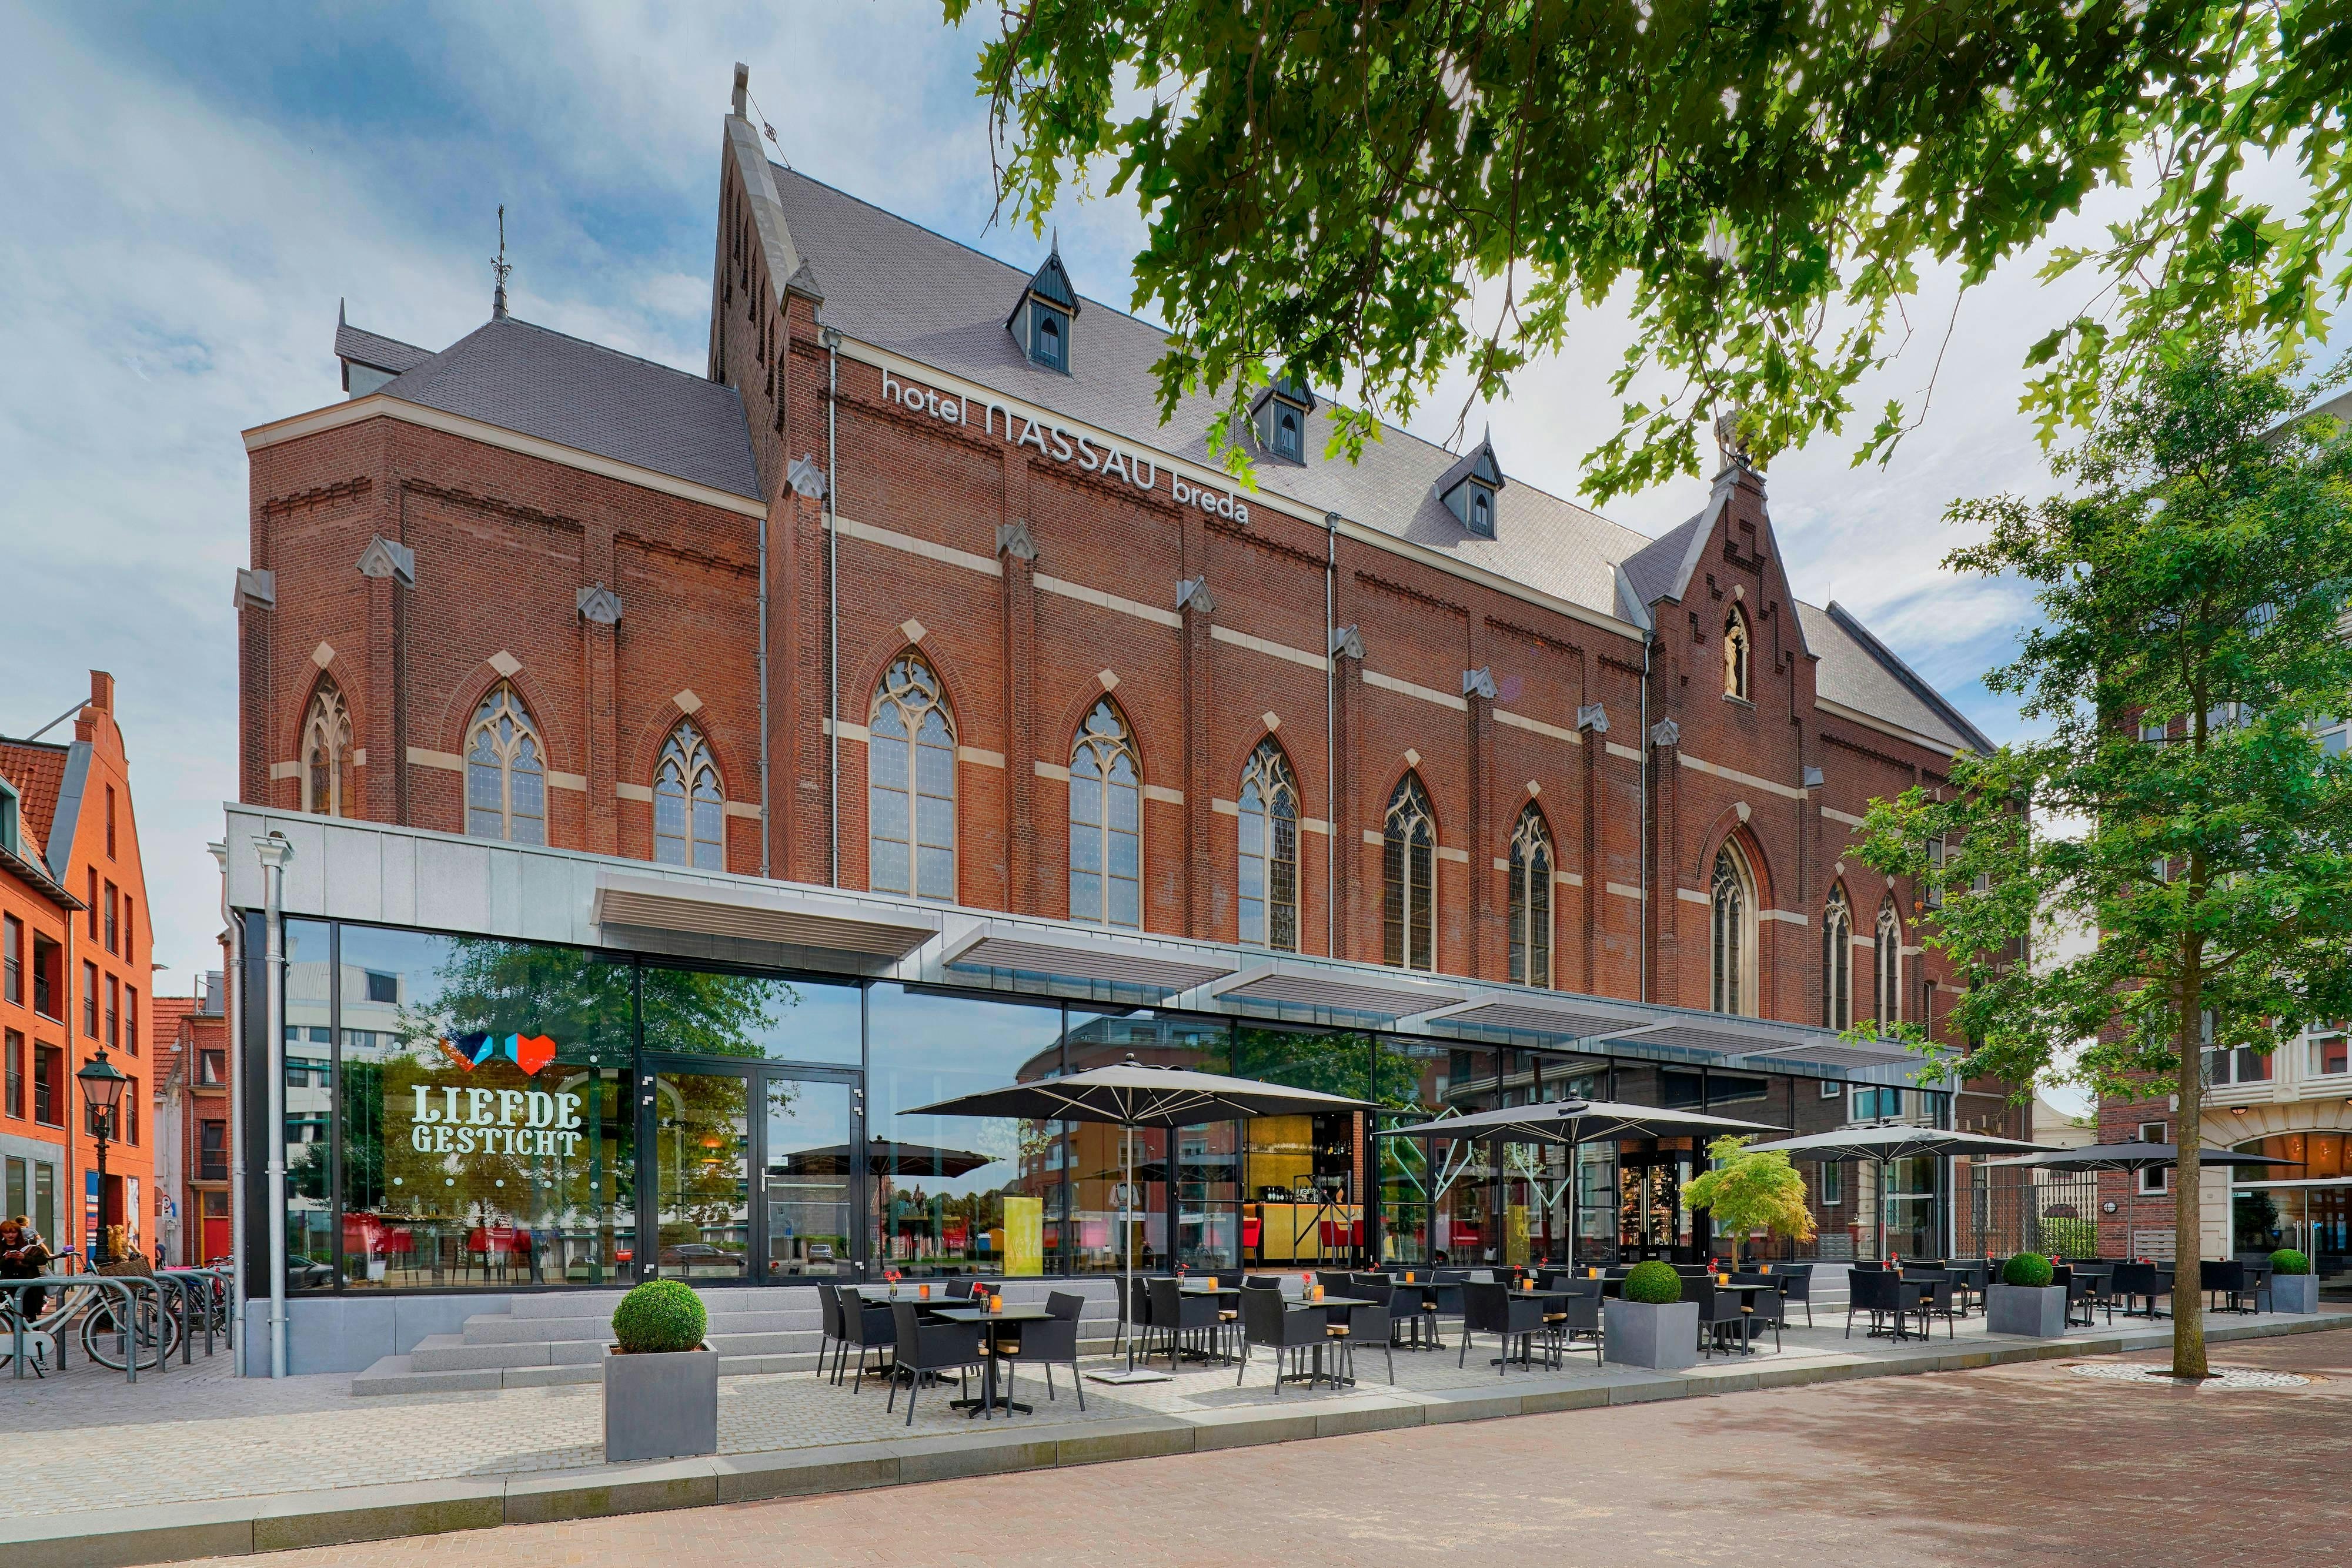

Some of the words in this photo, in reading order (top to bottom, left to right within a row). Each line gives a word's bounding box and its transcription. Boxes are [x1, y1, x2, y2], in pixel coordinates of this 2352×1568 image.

[883, 366, 967, 427] hotel
[1172, 471, 1249, 524] breda
[411, 1084, 582, 1129] LIEFDE
[412, 1125, 582, 1157] GESTICHT
